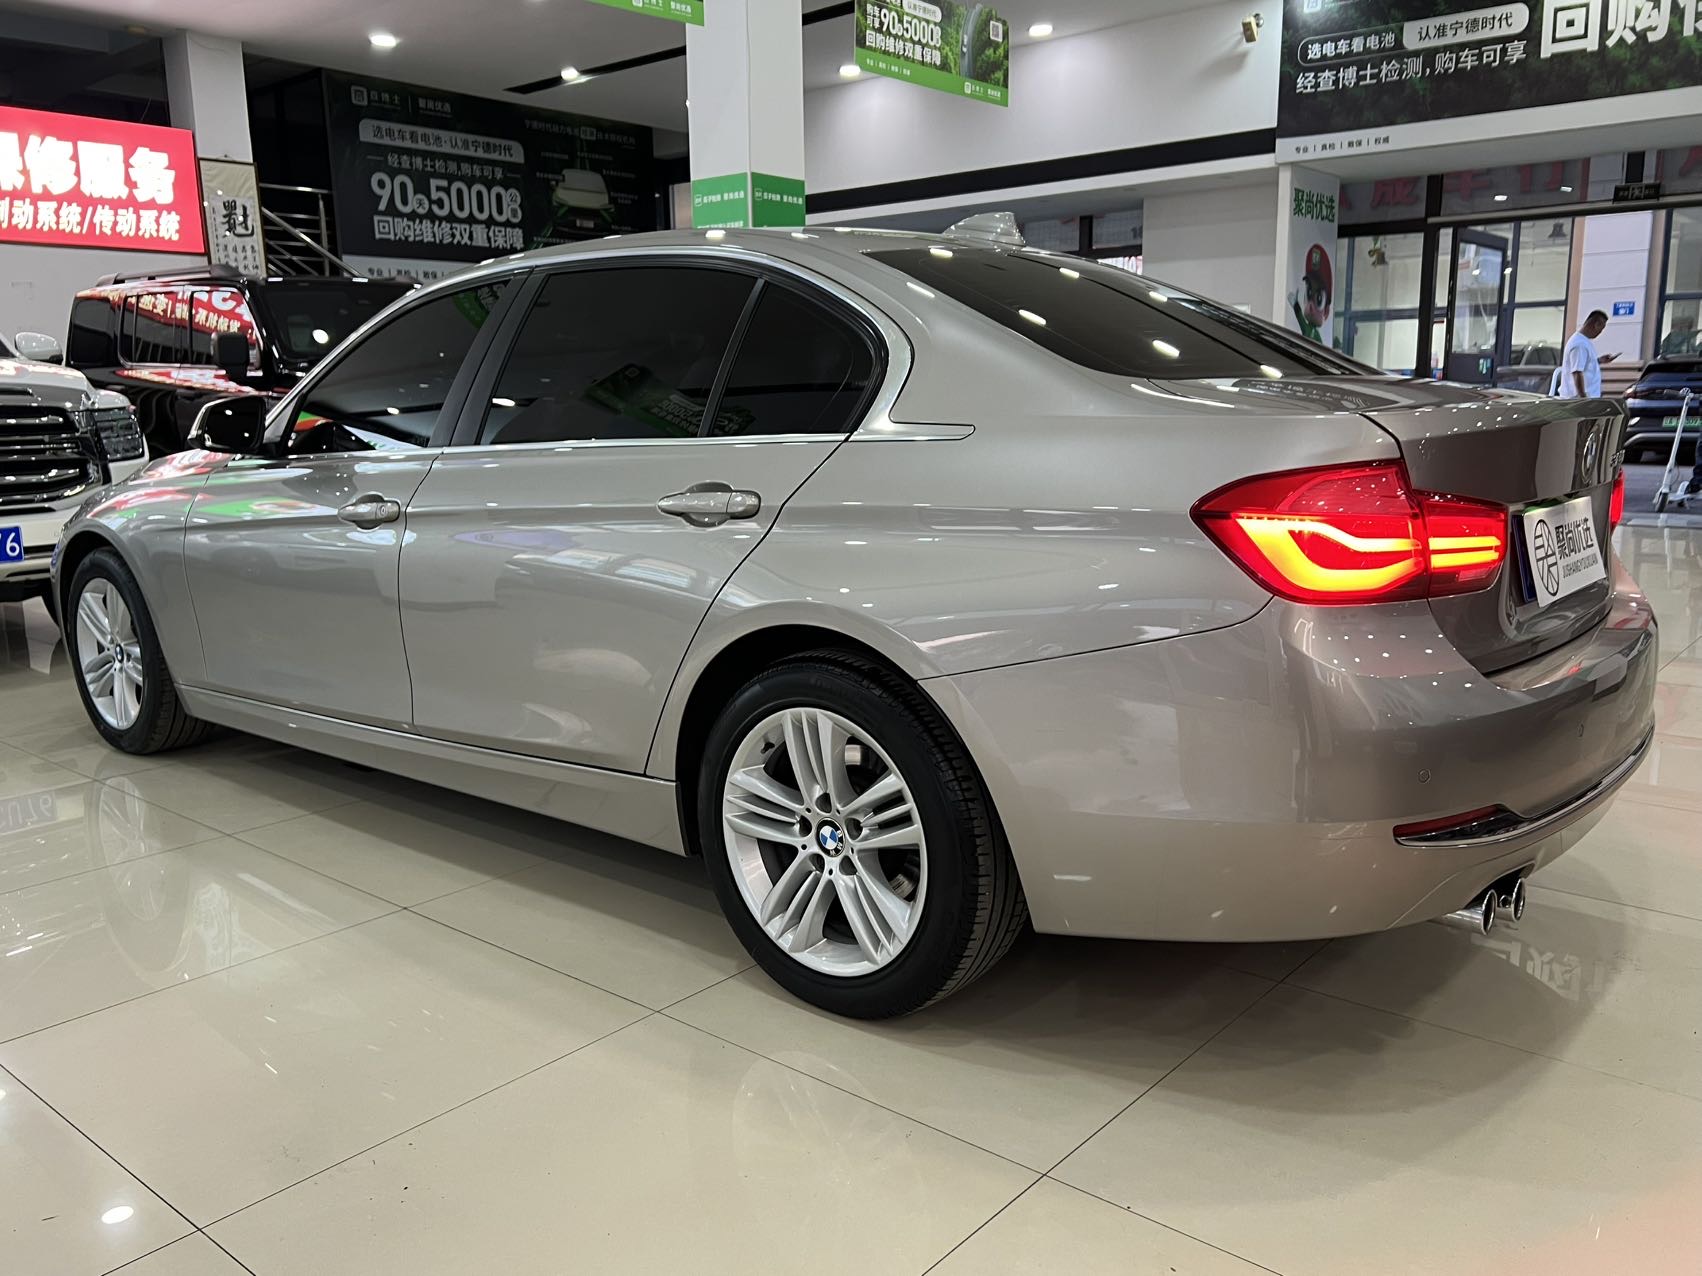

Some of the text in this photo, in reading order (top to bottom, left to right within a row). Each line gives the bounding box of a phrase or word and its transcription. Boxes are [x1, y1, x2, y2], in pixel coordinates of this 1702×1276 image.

[1417, 12, 1513, 42] 认准宁德时代
[1307, 31, 1395, 60] 选电车看电池
[1293, 186, 1336, 224] 聚尚优选
[373, 215, 524, 250] 回购维修双重保障
[1554, 516, 1594, 560] 聚尚优选
